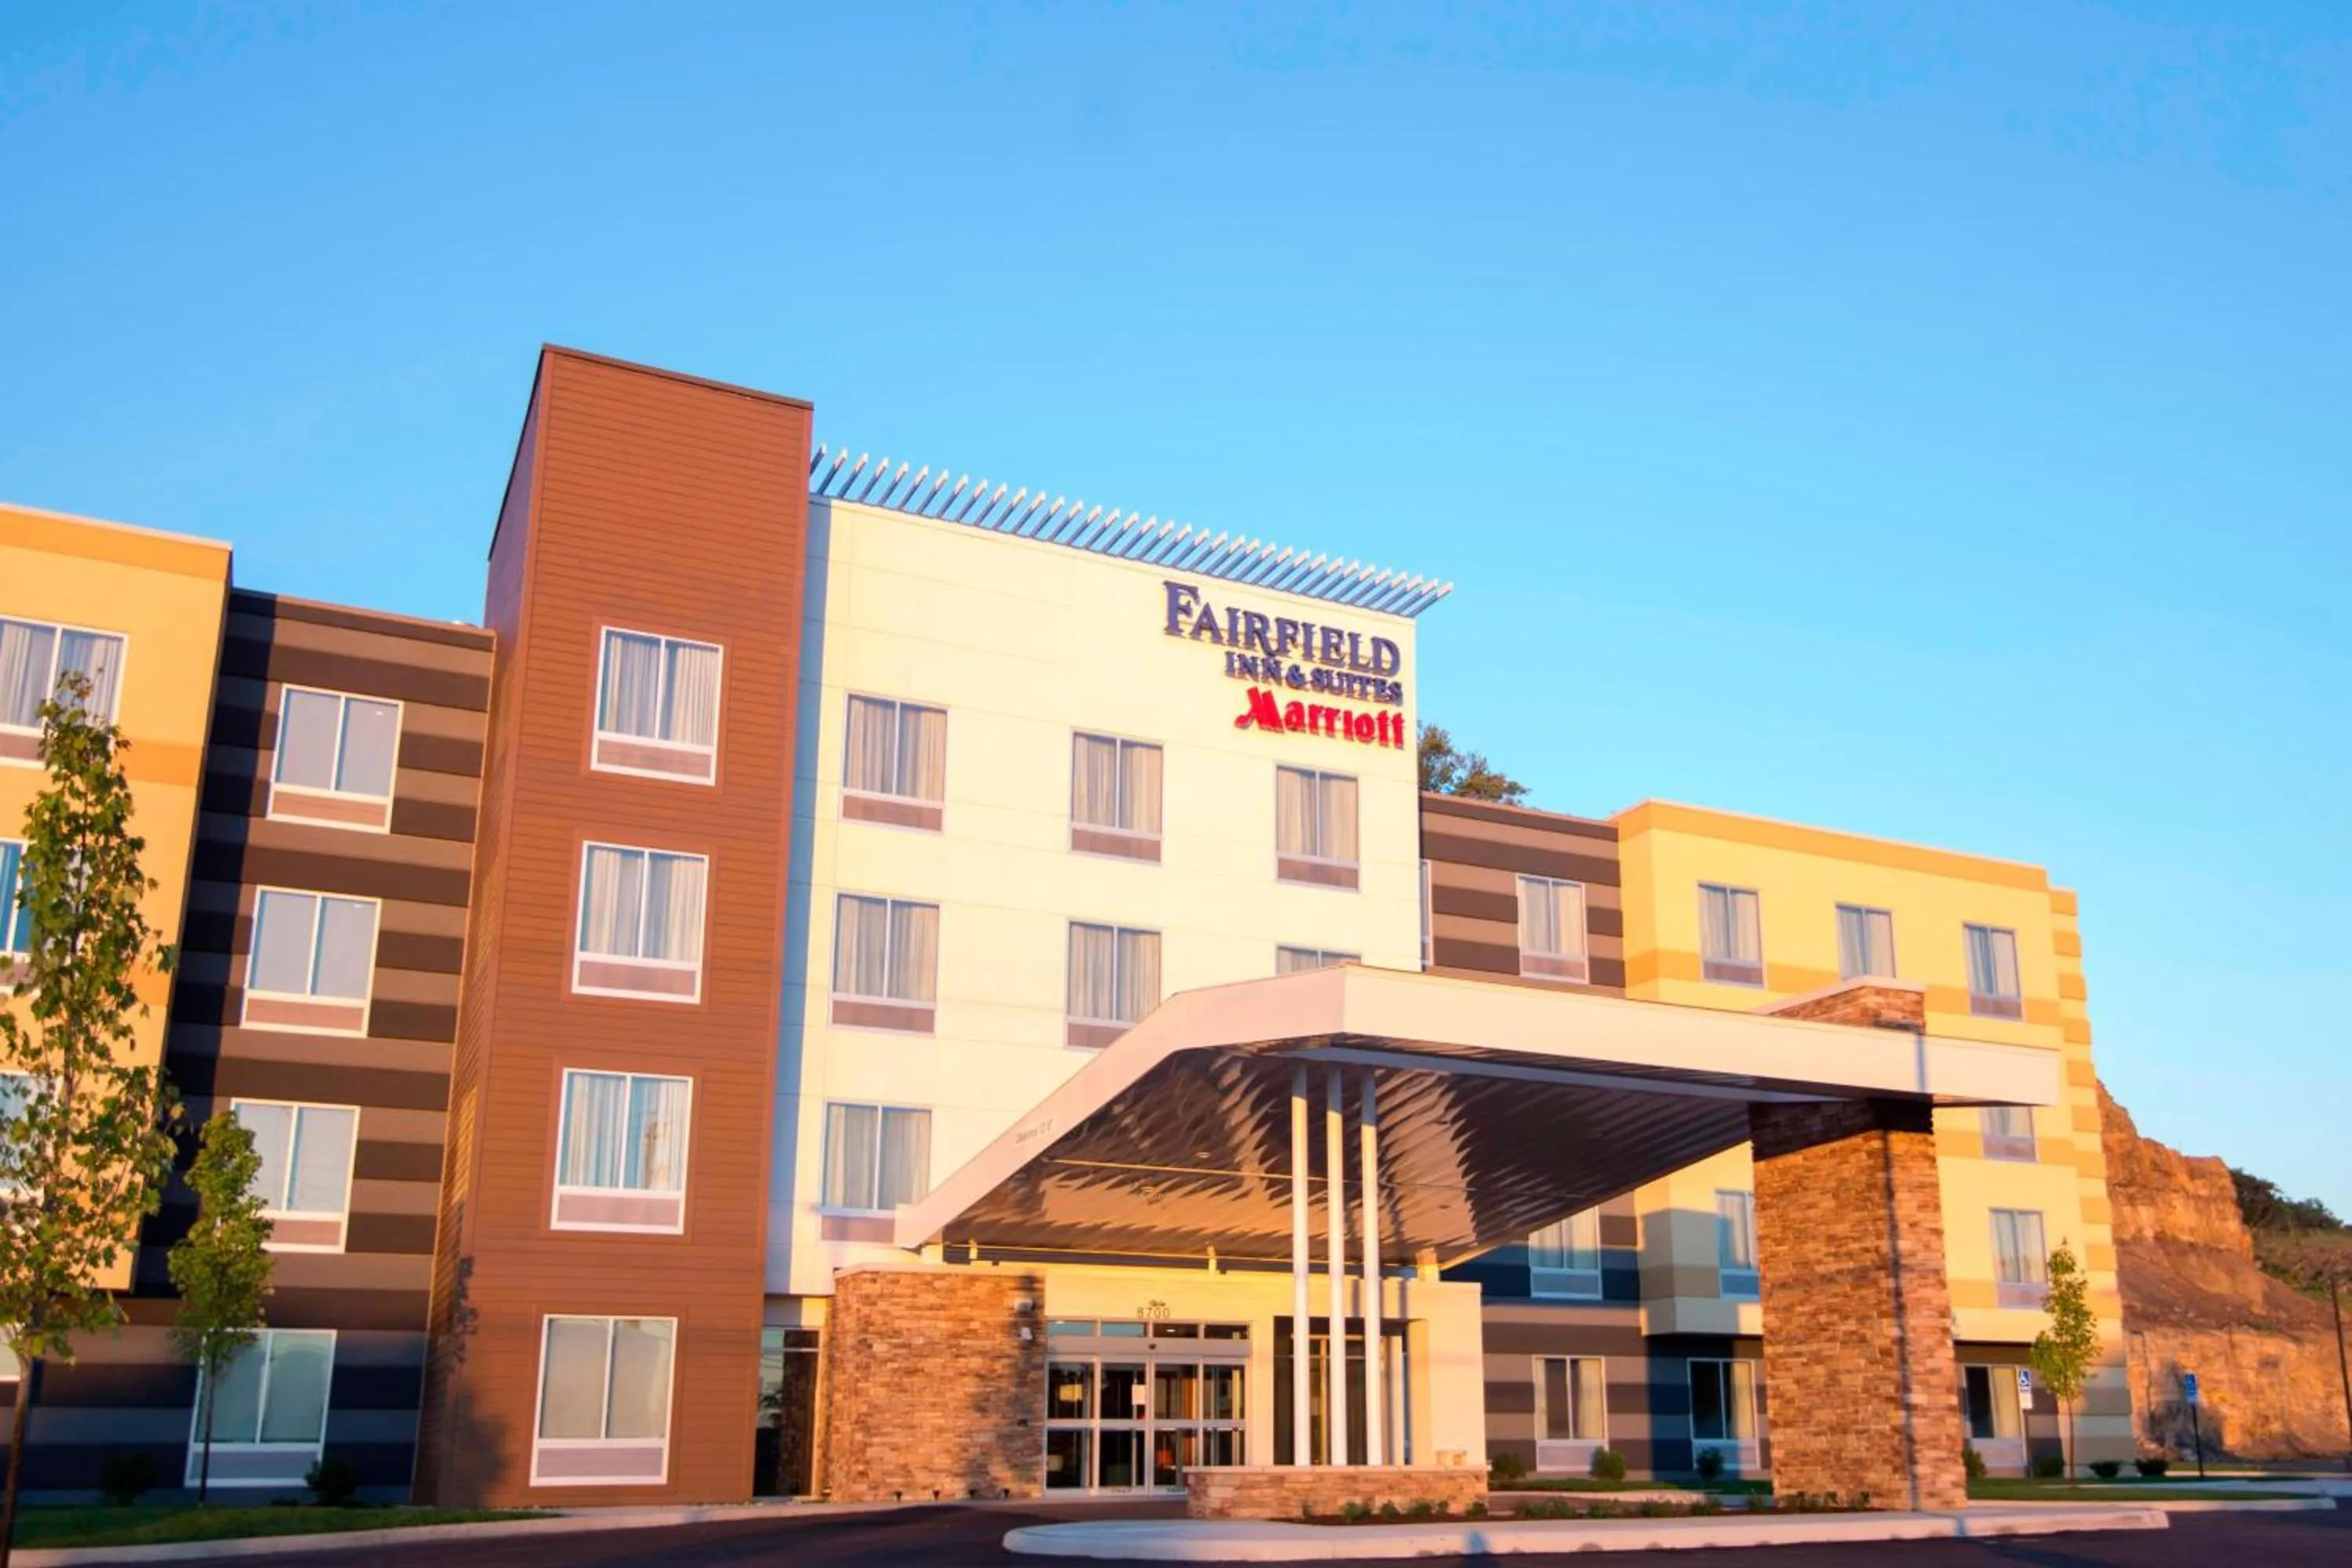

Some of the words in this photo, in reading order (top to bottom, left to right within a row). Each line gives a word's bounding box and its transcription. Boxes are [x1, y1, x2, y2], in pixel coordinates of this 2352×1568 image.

[1163, 580, 1401, 677] FAIRFIELD
[1225, 651, 1282, 687] INN
[1309, 666, 1403, 706] SUITES
[1234, 686, 1405, 750] Marriott
[1137, 1306, 1171, 1319] 8700
